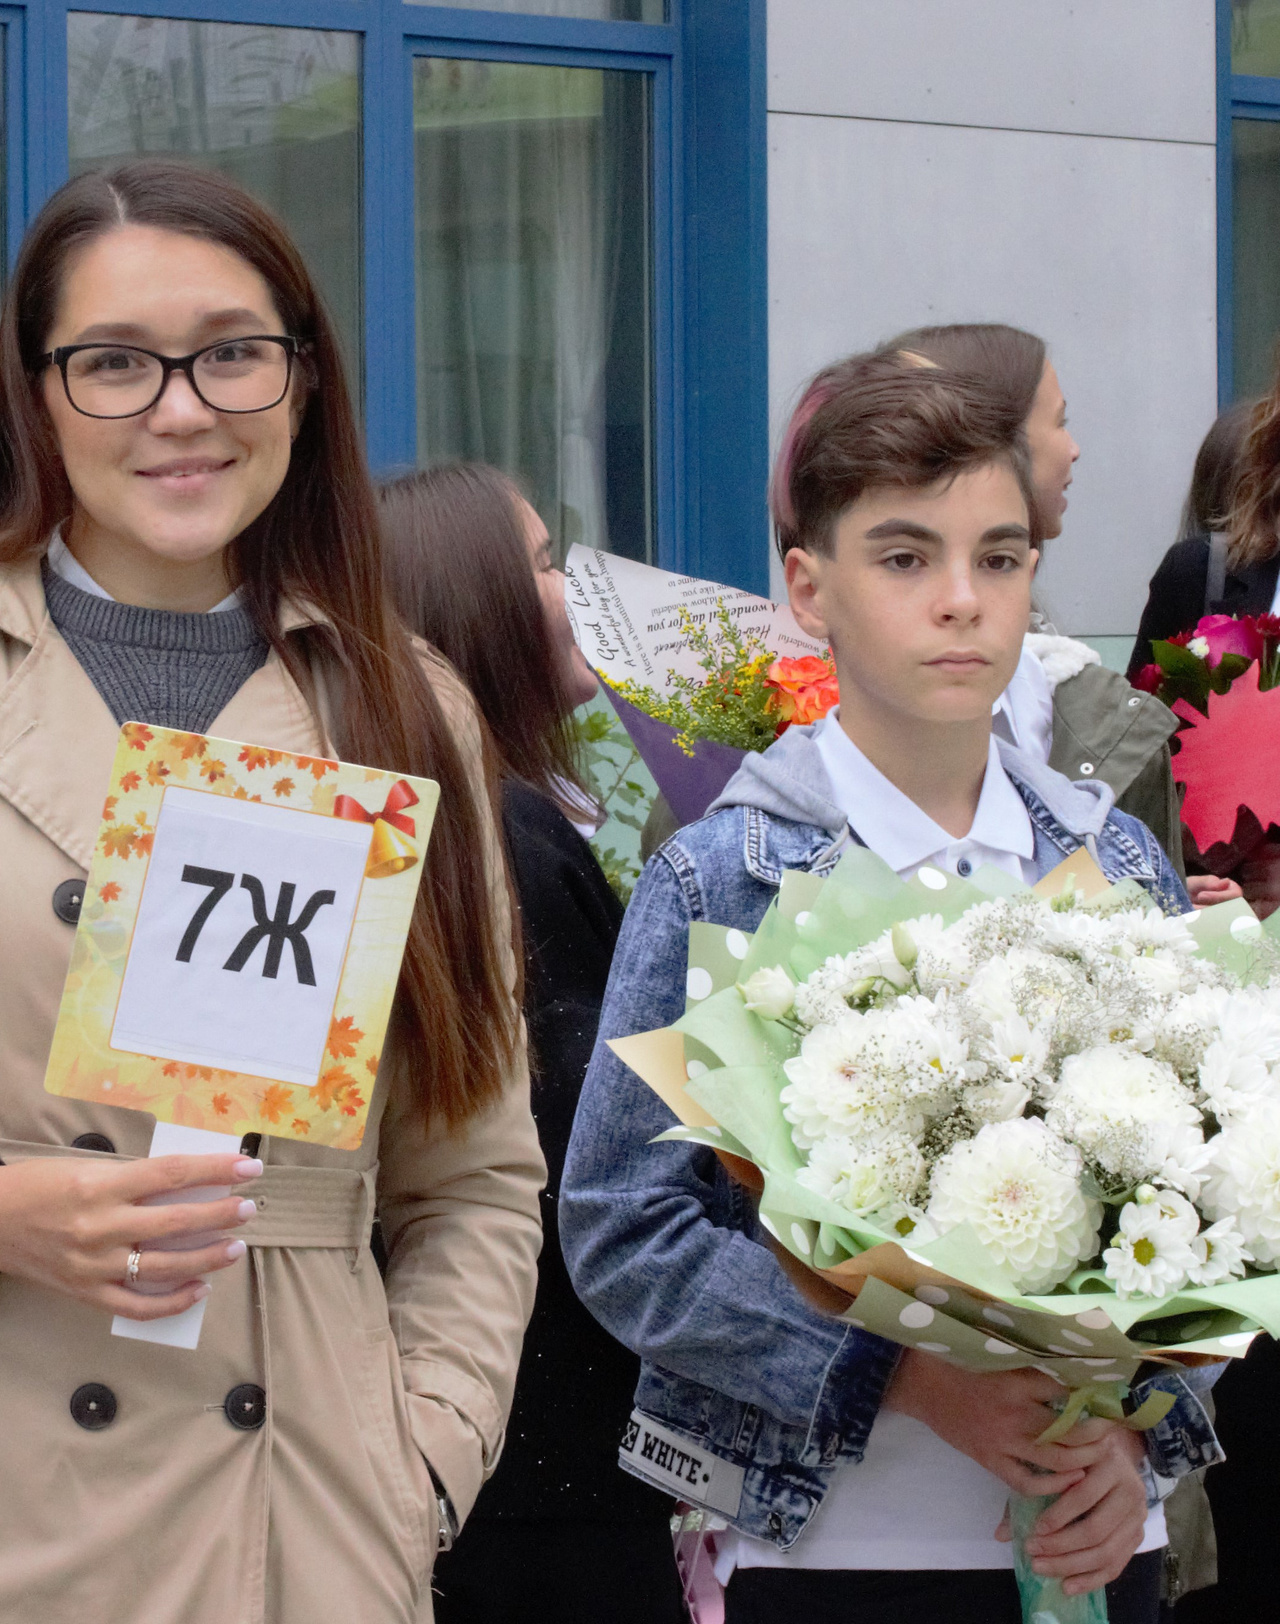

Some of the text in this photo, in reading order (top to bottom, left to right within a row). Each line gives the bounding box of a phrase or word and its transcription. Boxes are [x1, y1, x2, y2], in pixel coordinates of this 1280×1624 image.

[699, 585, 715, 594] like
[583, 563, 637, 668] A wonderful day for you
[611, 594, 635, 635] beautiful
[651, 604, 688, 617] wonderful
[771, 602, 780, 613] A
[647, 621, 666, 632] you
[667, 617, 684, 630] for
[584, 622, 619, 661] Good
[635, 643, 644, 653] is
[777, 633, 820, 653] wonderful
[641, 652, 654, 676] Here
[175, 864, 336, 987] 7Ж
[640, 1431, 702, 1485] WHITE
